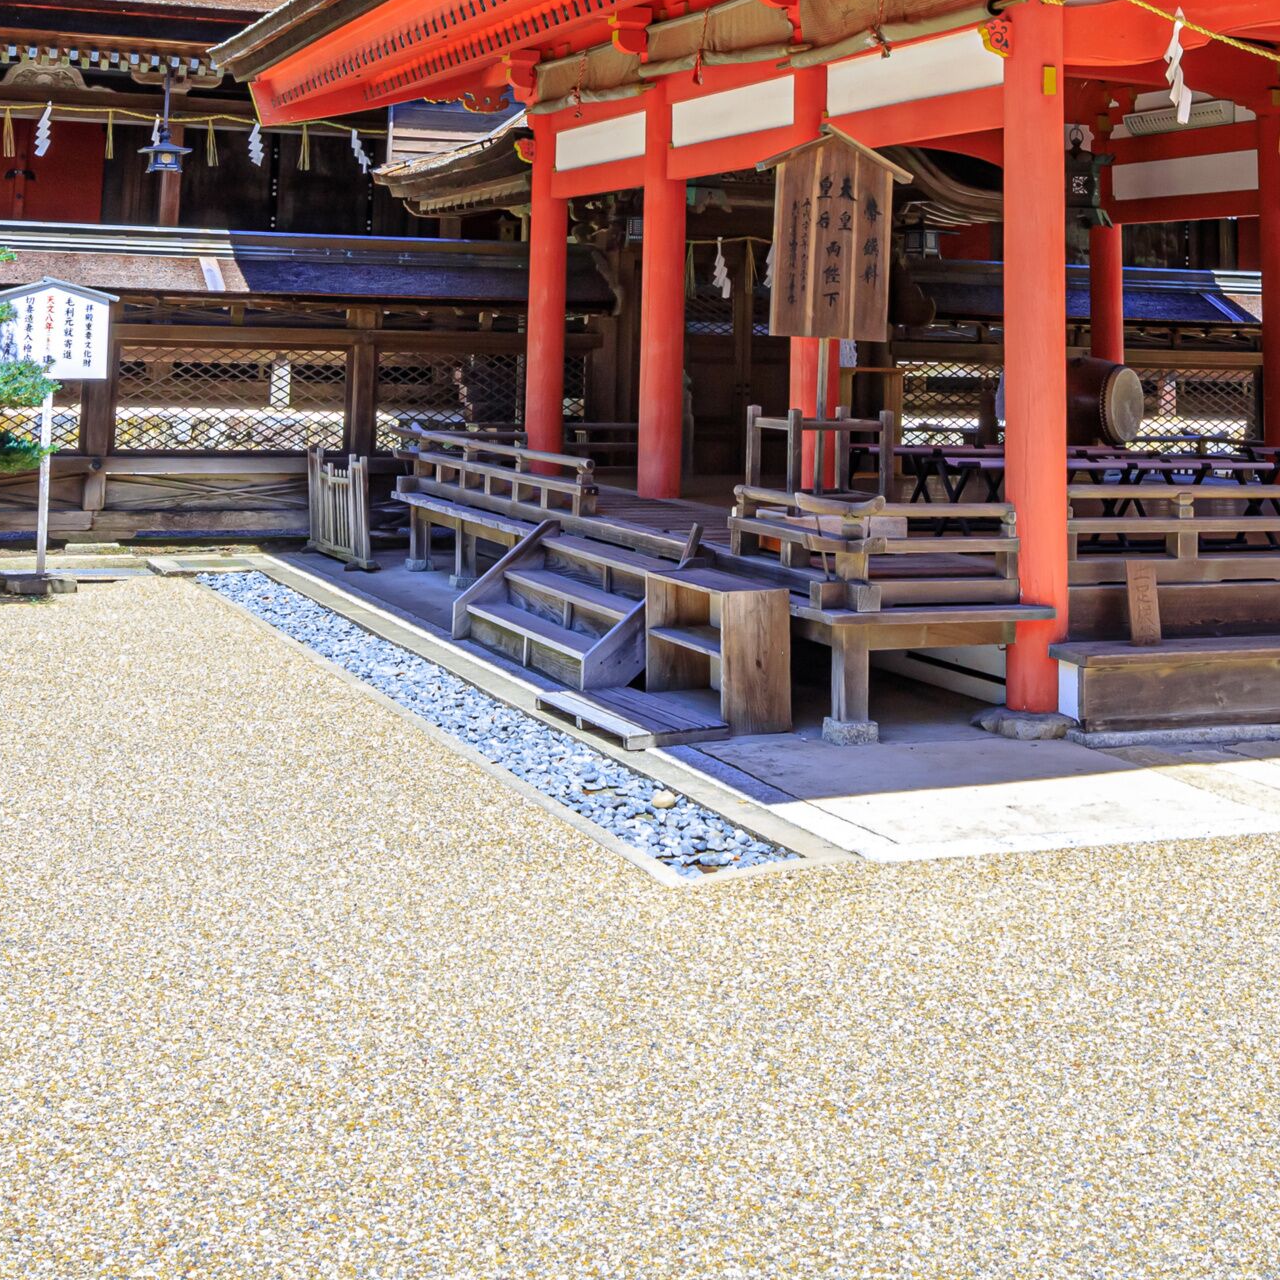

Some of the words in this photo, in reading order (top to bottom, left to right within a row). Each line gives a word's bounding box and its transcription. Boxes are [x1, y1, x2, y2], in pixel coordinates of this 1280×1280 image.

[817, 176, 833, 229] 皇后
[837, 177, 857, 231] 天皇
[64, 297, 75, 360] 毛利元就寄進
[83, 305, 94, 368] 拝殿重要文化財
